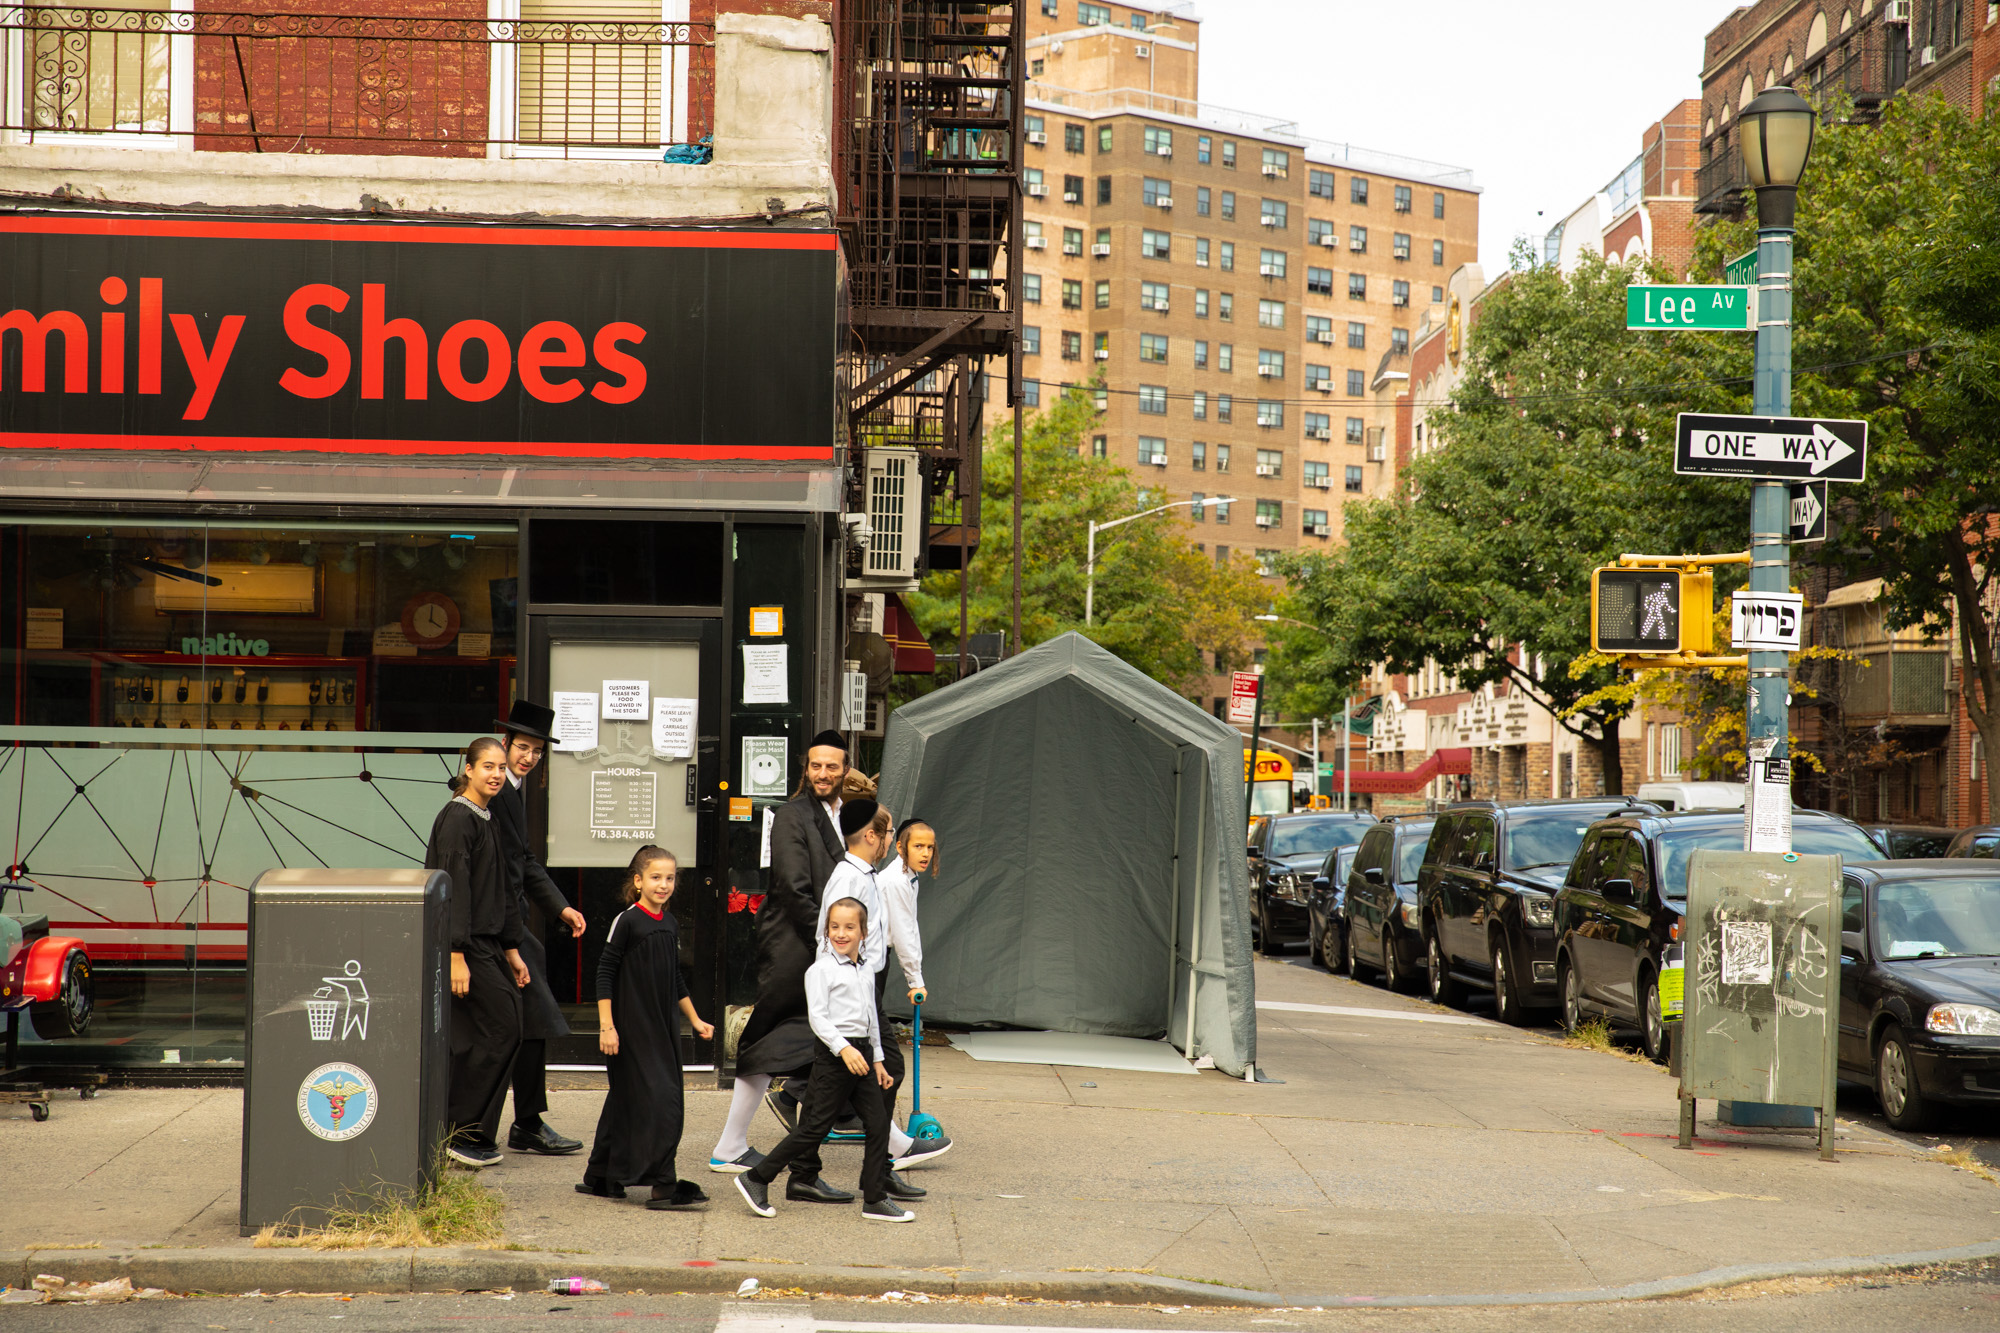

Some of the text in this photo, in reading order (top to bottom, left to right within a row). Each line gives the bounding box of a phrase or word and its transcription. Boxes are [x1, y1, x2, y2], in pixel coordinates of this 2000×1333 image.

[1645, 291, 1734, 323] Lee Av
[278, 282, 648, 405] Shoes
[1704, 434, 1837, 461] ONE WAY
[1794, 499, 1815, 524] WAY
[182, 632, 269, 656] native
[607, 768, 641, 776] HOURS
[590, 830, 655, 839] 718.384.4816
[308, 1072, 318, 1084] THE
[318, 1065, 333, 1075] CITY
[344, 1065, 358, 1074] NEW
[358, 1073, 371, 1087] YORK
[300, 1086, 328, 1138] DEPARTMENT
[343, 1091, 375, 1138] SANITATION
[330, 1096, 344, 1119] S
